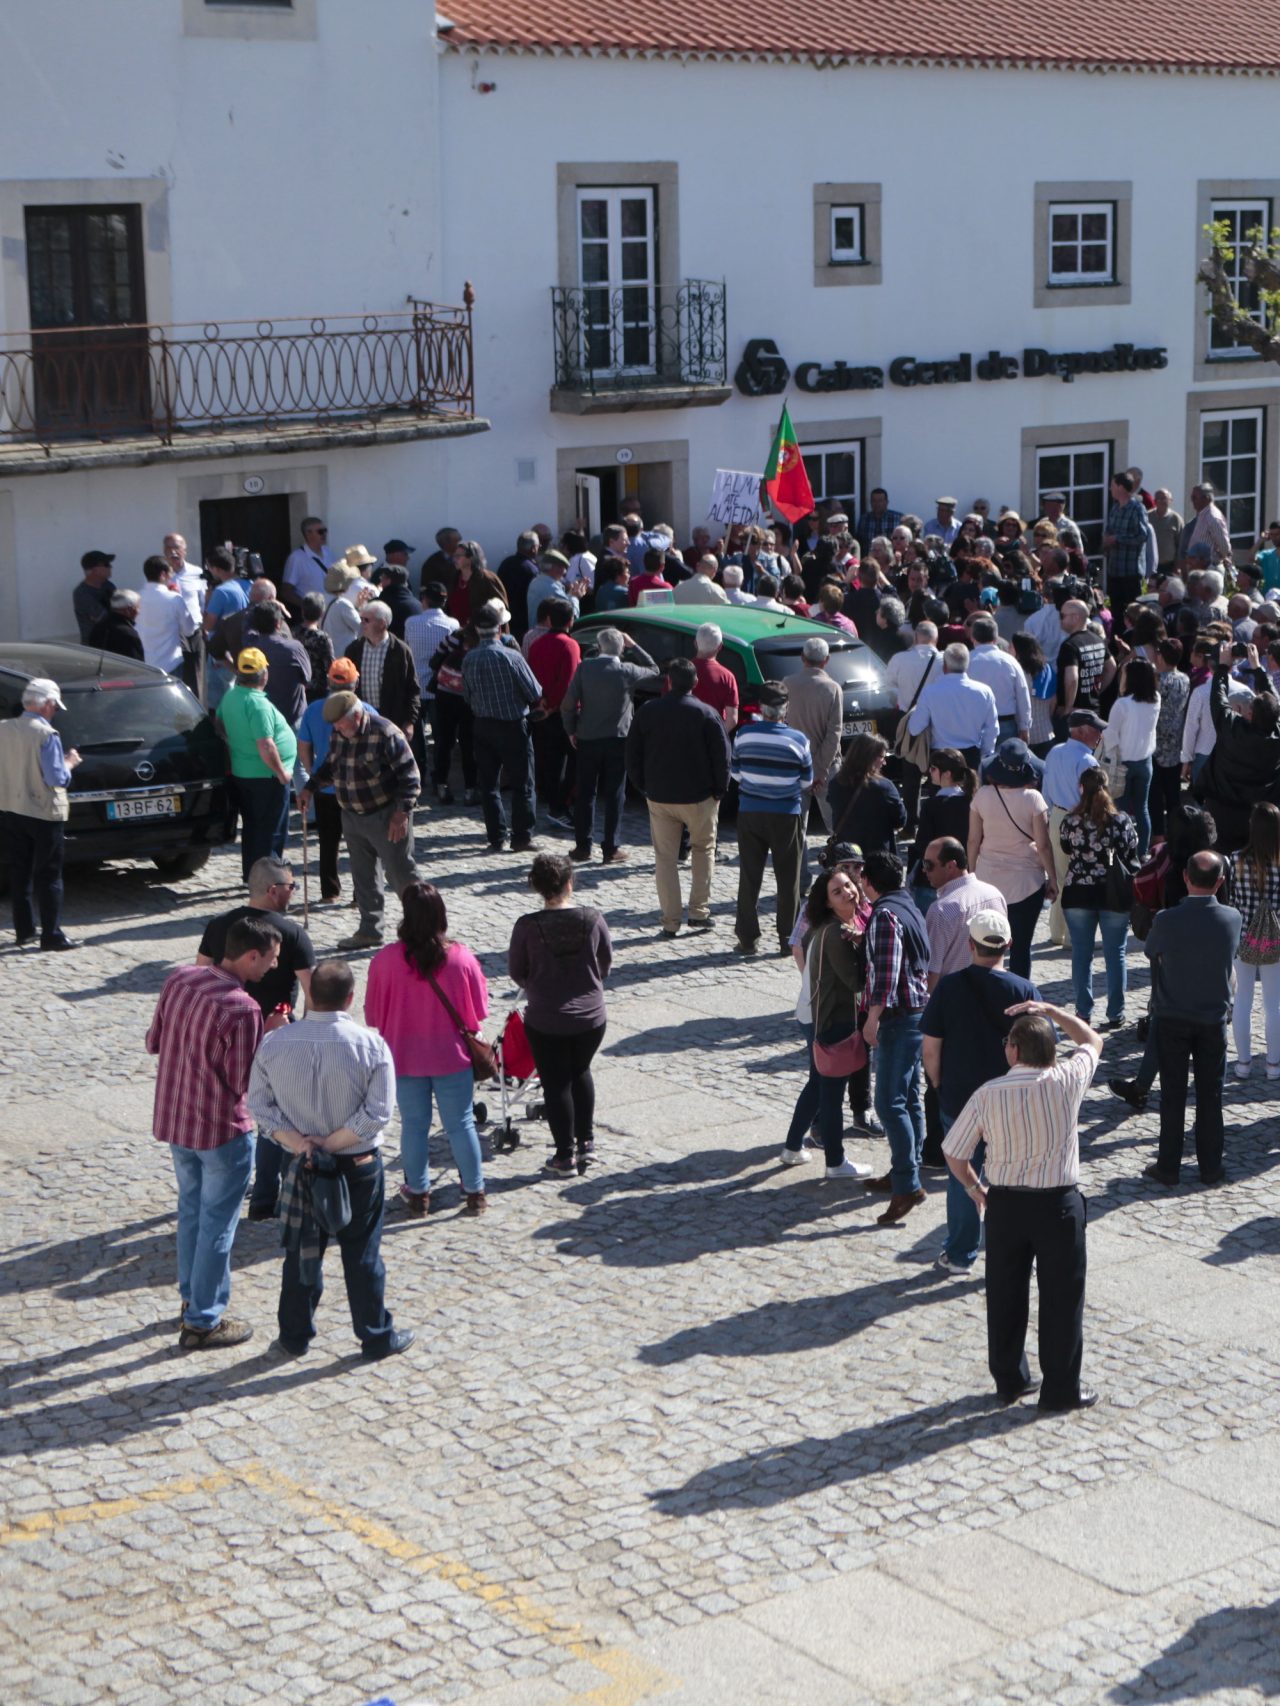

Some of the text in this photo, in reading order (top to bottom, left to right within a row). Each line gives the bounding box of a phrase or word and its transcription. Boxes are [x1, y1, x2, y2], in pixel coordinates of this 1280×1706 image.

[795, 361, 884, 393] Caixa
[889, 352, 972, 387] Geral
[976, 350, 1019, 381] de
